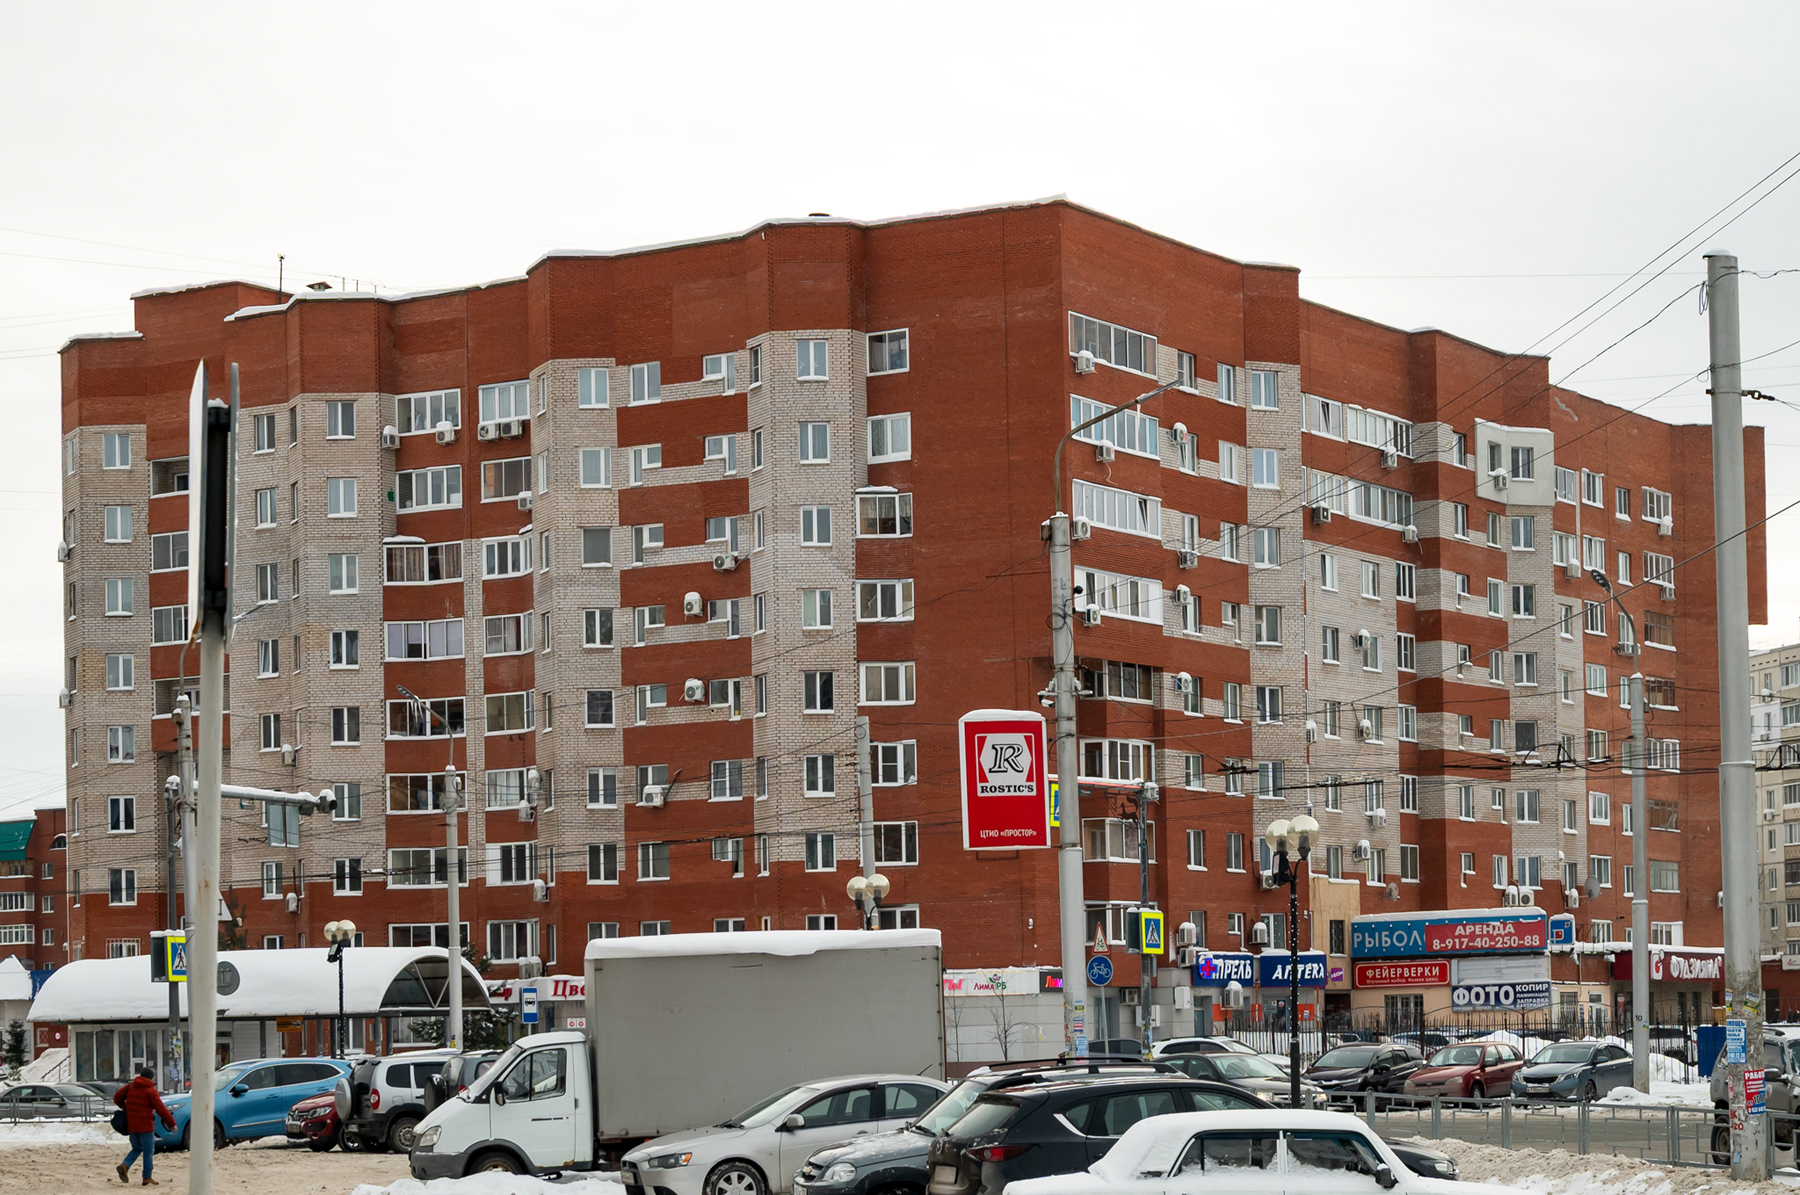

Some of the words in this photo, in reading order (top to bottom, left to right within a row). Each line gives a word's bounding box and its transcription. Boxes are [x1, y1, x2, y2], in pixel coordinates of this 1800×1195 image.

[980, 784, 1034, 793] ROSTIC'S
[980, 830, 999, 838] ЦТИО
[1000, 829, 1037, 837] «ПРОСТОР»
[1455, 923, 1515, 935] АРЕНДА
[1353, 930, 1425, 948] РЫБОЛ
[1432, 935, 1540, 950] 8-917-40-250-88
[1366, 966, 1439, 979] ФЕЙЕРВЕРКИ
[1453, 985, 1514, 1005] ФОТО
[1516, 984, 1549, 992] КОПИР
